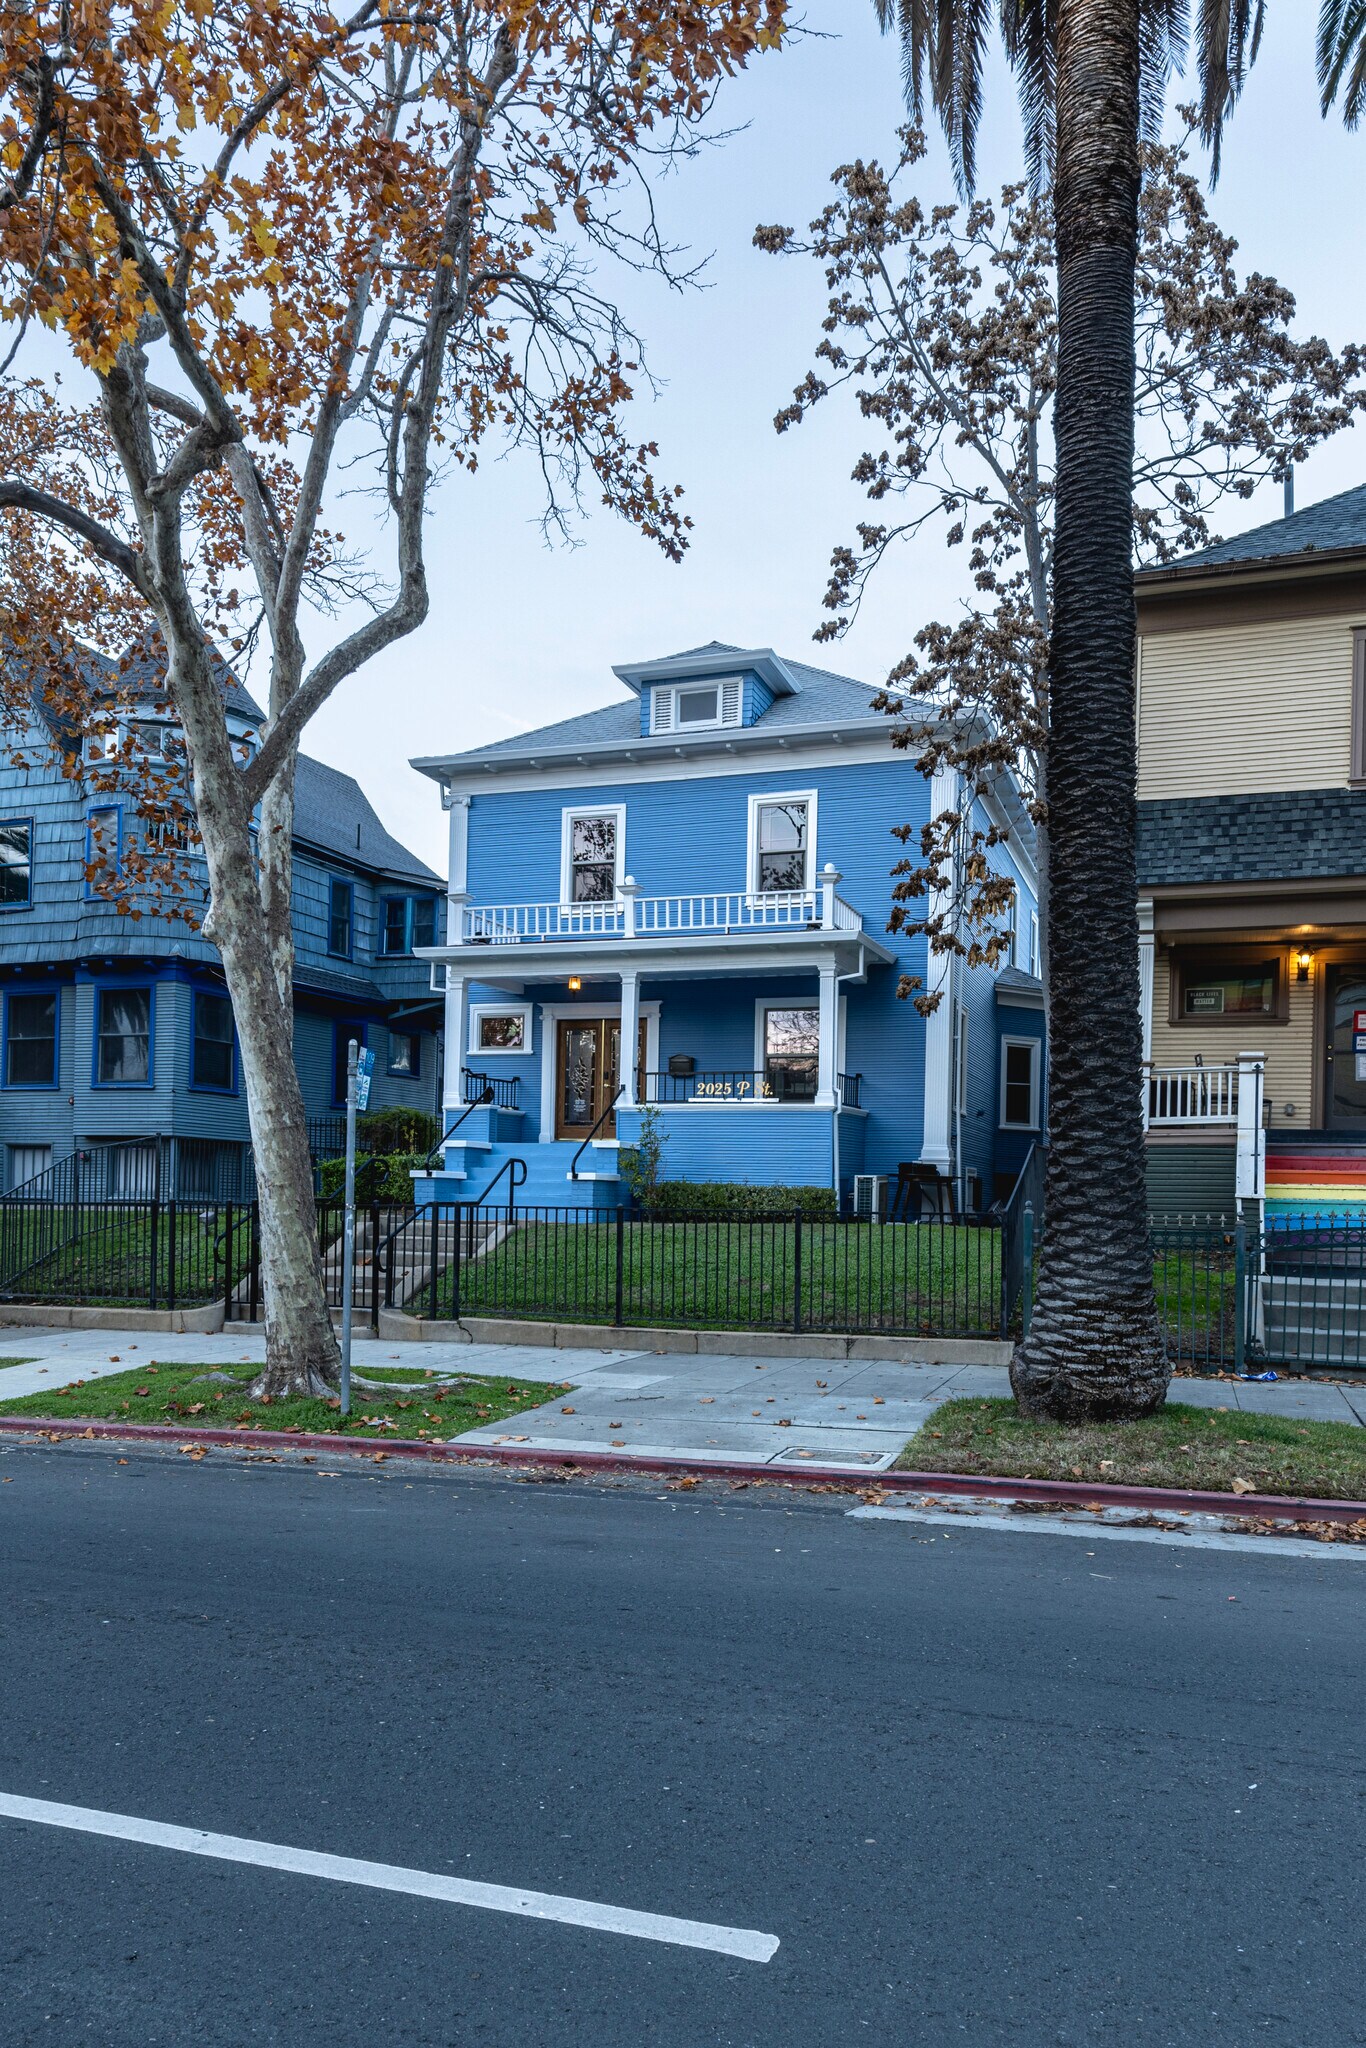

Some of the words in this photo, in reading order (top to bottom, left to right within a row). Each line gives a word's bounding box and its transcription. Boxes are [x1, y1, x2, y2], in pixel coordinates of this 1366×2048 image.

[696, 1082, 732, 1095] 2025
[736, 1080, 751, 1095] P
[754, 1081, 774, 1096] St.
